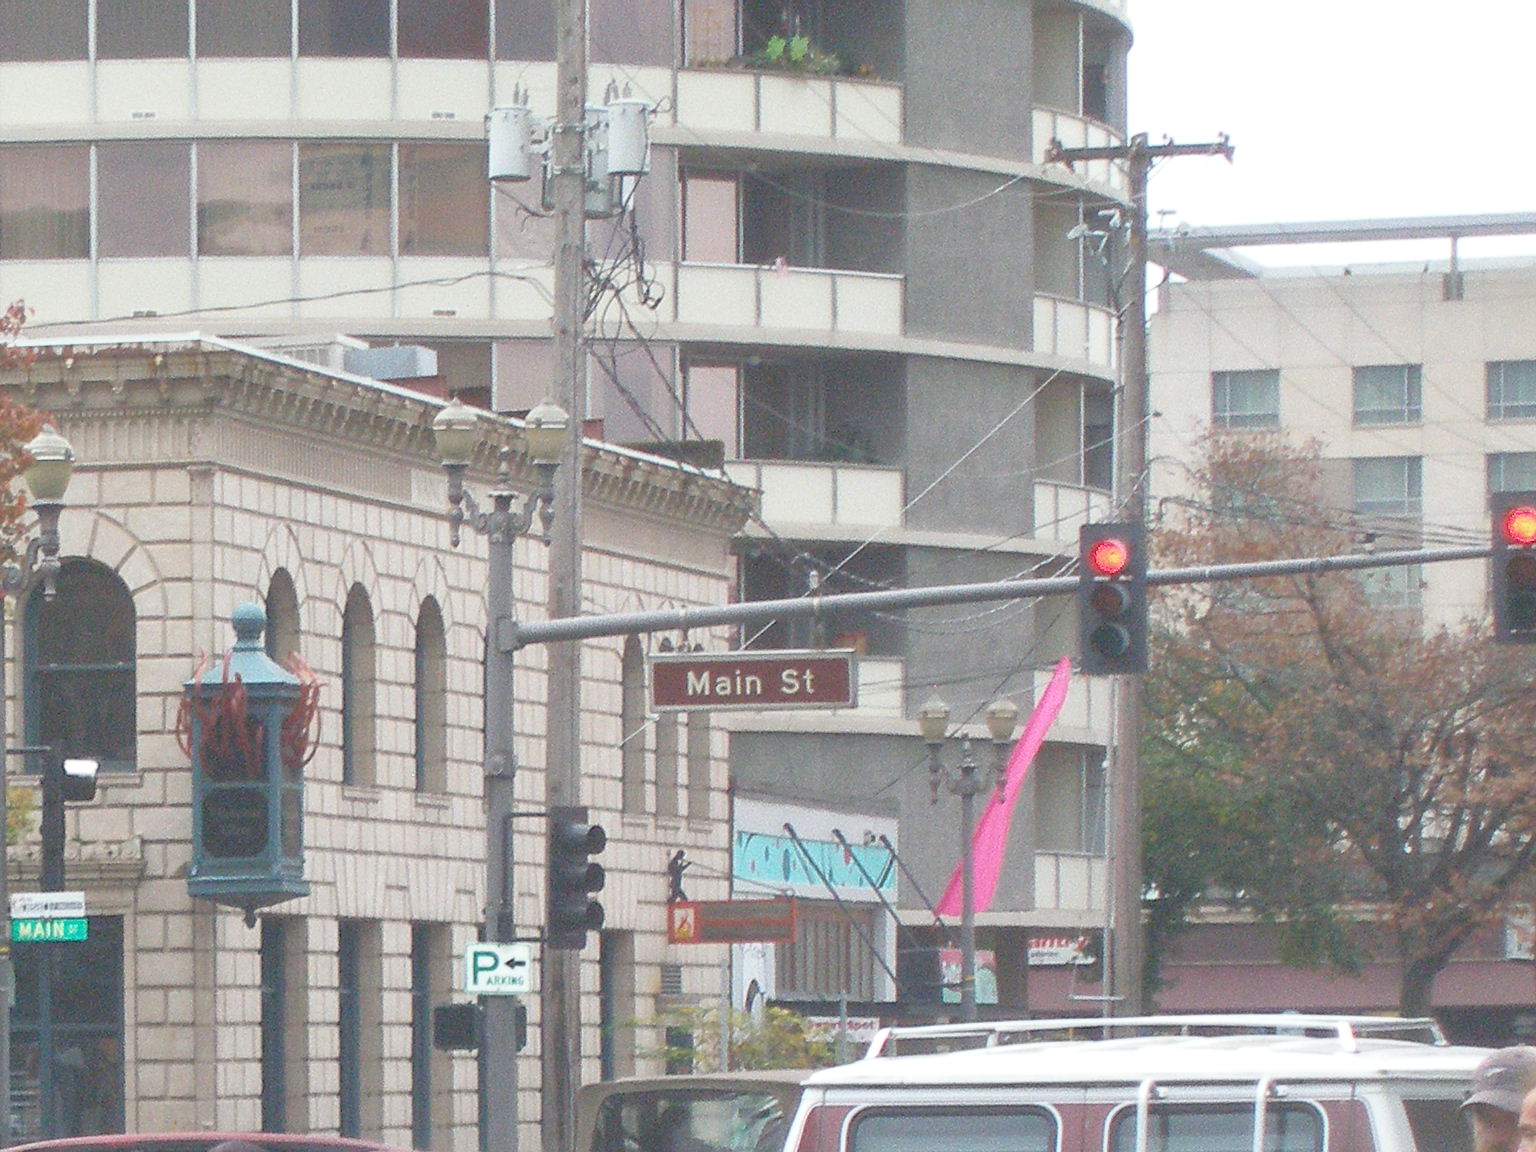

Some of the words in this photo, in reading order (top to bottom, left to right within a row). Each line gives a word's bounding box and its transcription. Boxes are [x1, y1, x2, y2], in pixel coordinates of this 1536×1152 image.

[686, 670, 762, 696] Main
[780, 668, 815, 695] St
[18, 921, 65, 939] MAIN
